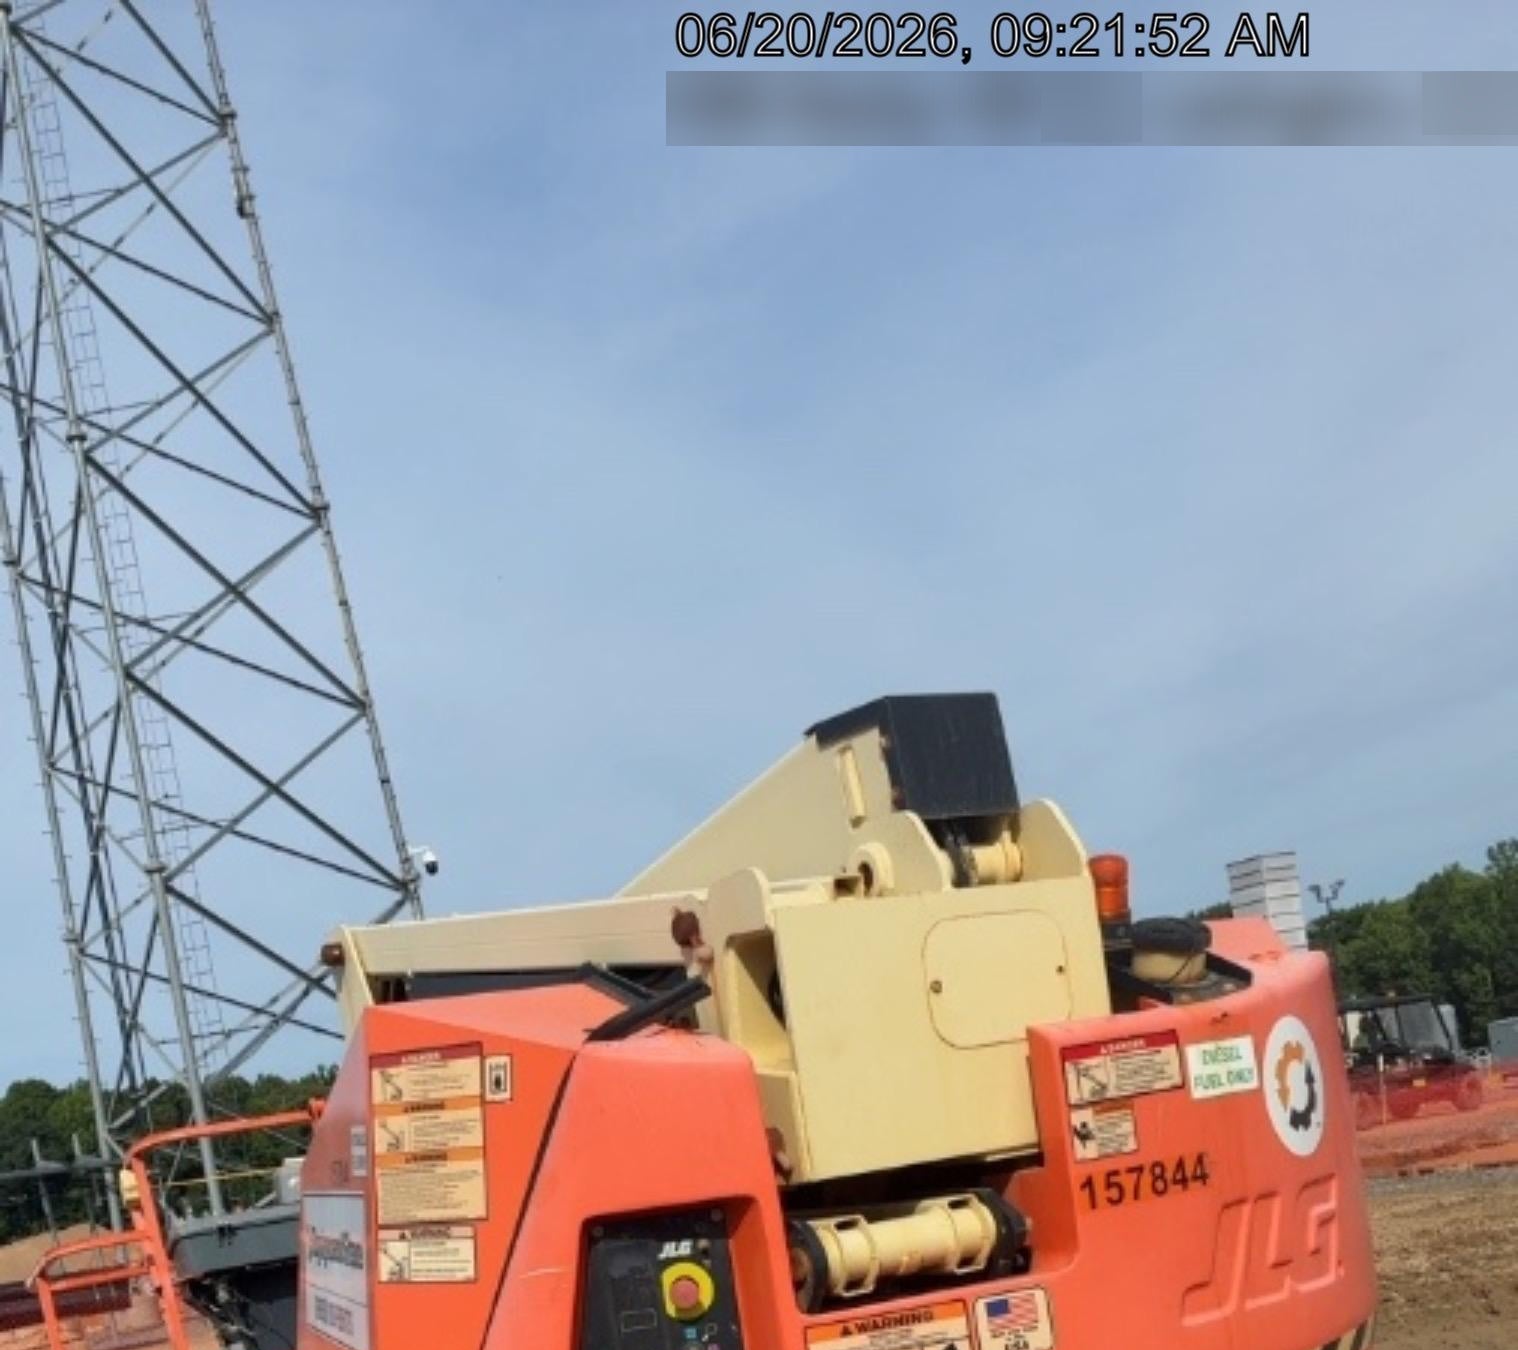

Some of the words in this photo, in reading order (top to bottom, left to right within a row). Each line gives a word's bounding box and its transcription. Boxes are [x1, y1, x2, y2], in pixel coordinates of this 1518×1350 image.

[1194, 1073, 1224, 1090] FUEL
[1080, 1152, 1209, 1210] 157844
[657, 1239, 695, 1261] JLG
[1181, 1174, 1338, 1328] JLG
[855, 1310, 934, 1334] WARNING
